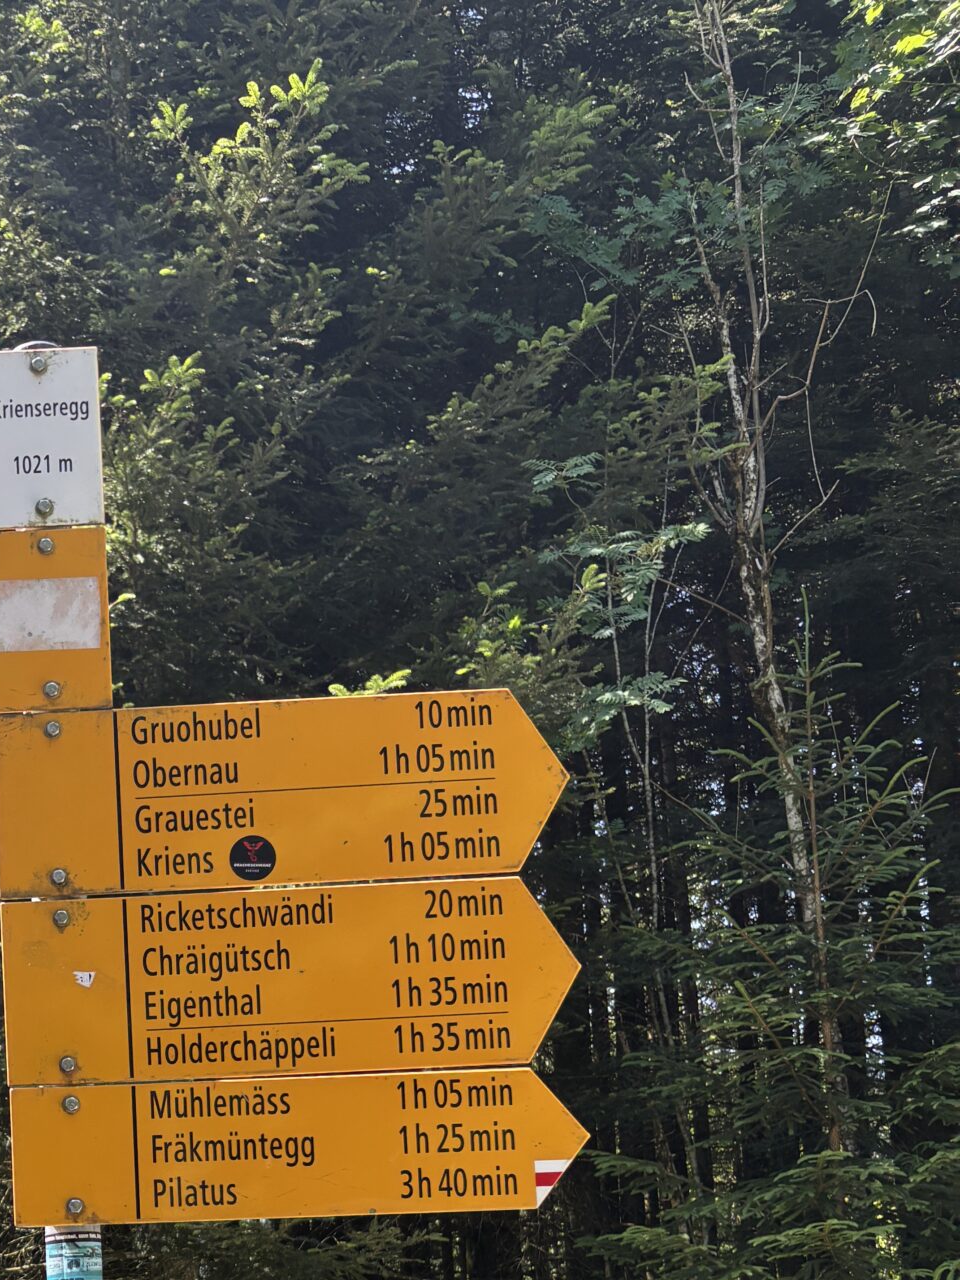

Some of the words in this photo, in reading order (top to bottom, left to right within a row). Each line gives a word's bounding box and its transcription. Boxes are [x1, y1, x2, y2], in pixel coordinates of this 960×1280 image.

[13, 455, 52, 475] 1021
[57, 460, 73, 473] m
[131, 708, 261, 744] Gruohubel
[133, 760, 239, 788] Obernau
[135, 799, 255, 834] Grauestei
[137, 848, 214, 877] Kriens
[141, 894, 334, 933] Ricketschwändi
[142, 940, 290, 982] Chräigütsch
[145, 985, 262, 1027] Eigenthal
[146, 1027, 336, 1069] Holderchäppeli
[150, 1085, 291, 1120] Mühlemäss
[151, 1131, 315, 1167] Fräkmüntegg
[153, 1178, 238, 1208] Pilatus
